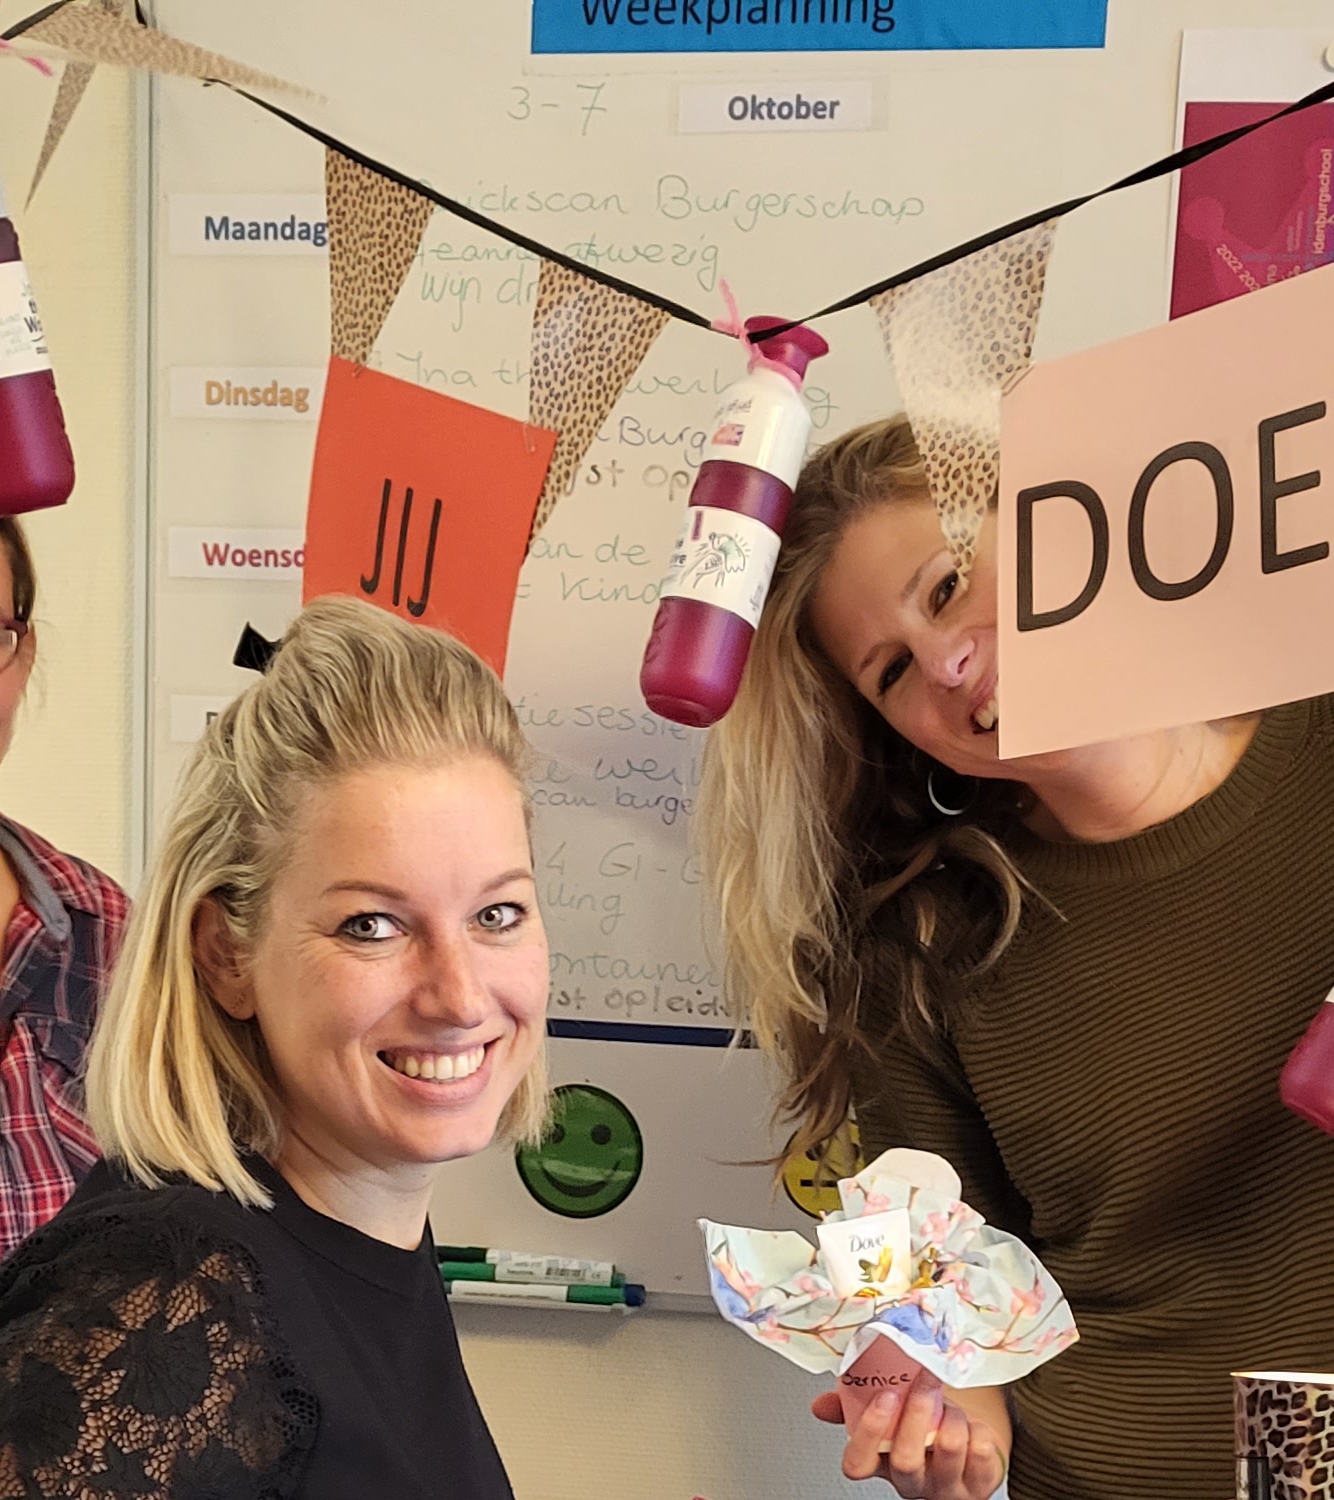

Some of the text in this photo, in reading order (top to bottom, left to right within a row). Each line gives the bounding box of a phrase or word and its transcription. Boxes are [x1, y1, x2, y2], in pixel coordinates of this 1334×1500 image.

[728, 95, 841, 121] Oktober
[204, 215, 328, 248] Maandag
[205, 379, 310, 413] Dinsdag
[360, 478, 443, 617] JIJ
[595, 534, 651, 565] de
[849, 1233, 886, 1253] Dove
